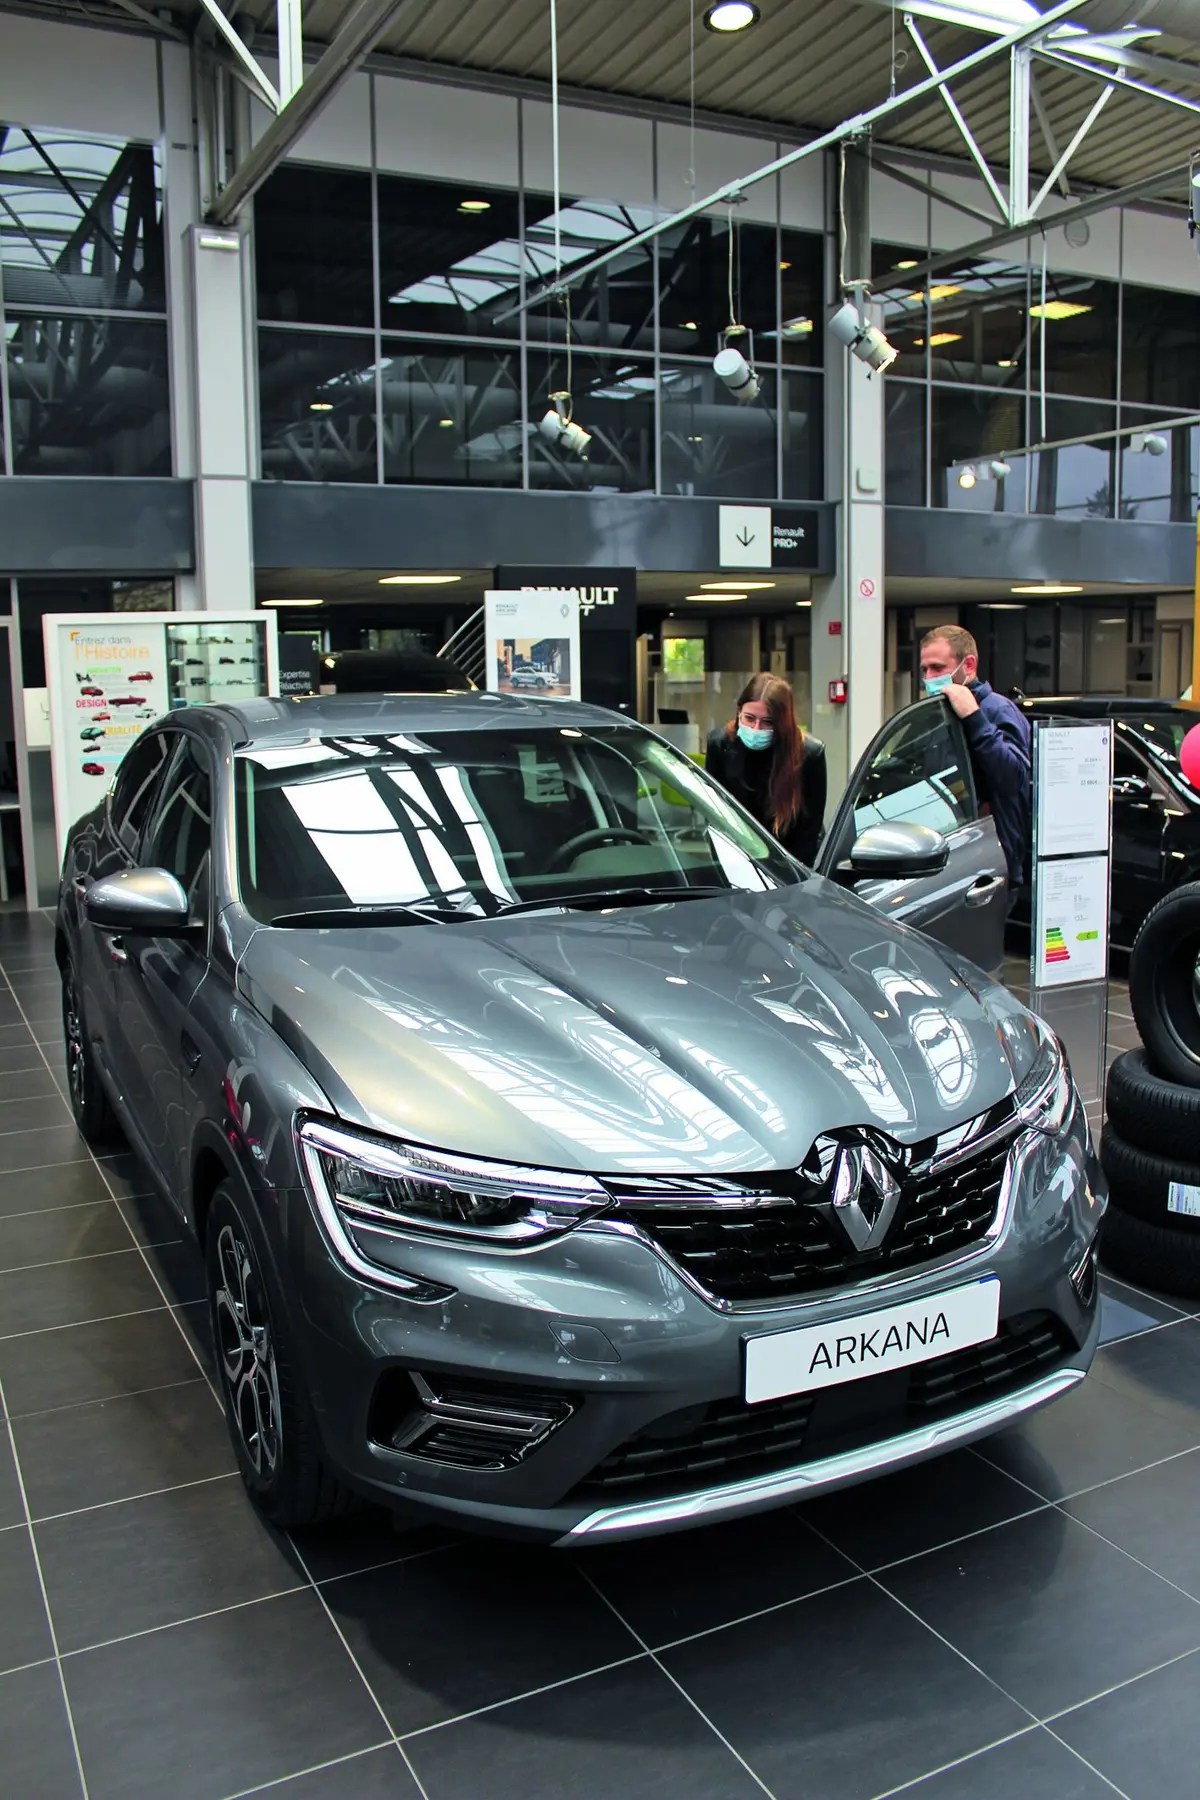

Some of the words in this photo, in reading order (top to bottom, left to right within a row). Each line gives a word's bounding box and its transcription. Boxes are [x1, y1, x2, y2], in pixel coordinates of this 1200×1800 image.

[773, 526, 805, 537] Renault
[773, 538, 798, 548] PRO+
[75, 636, 105, 645] Entrez
[75, 644, 150, 662] l'Histoire
[76, 699, 107, 708] DESIGN
[808, 1312, 950, 1374] ARKANA
